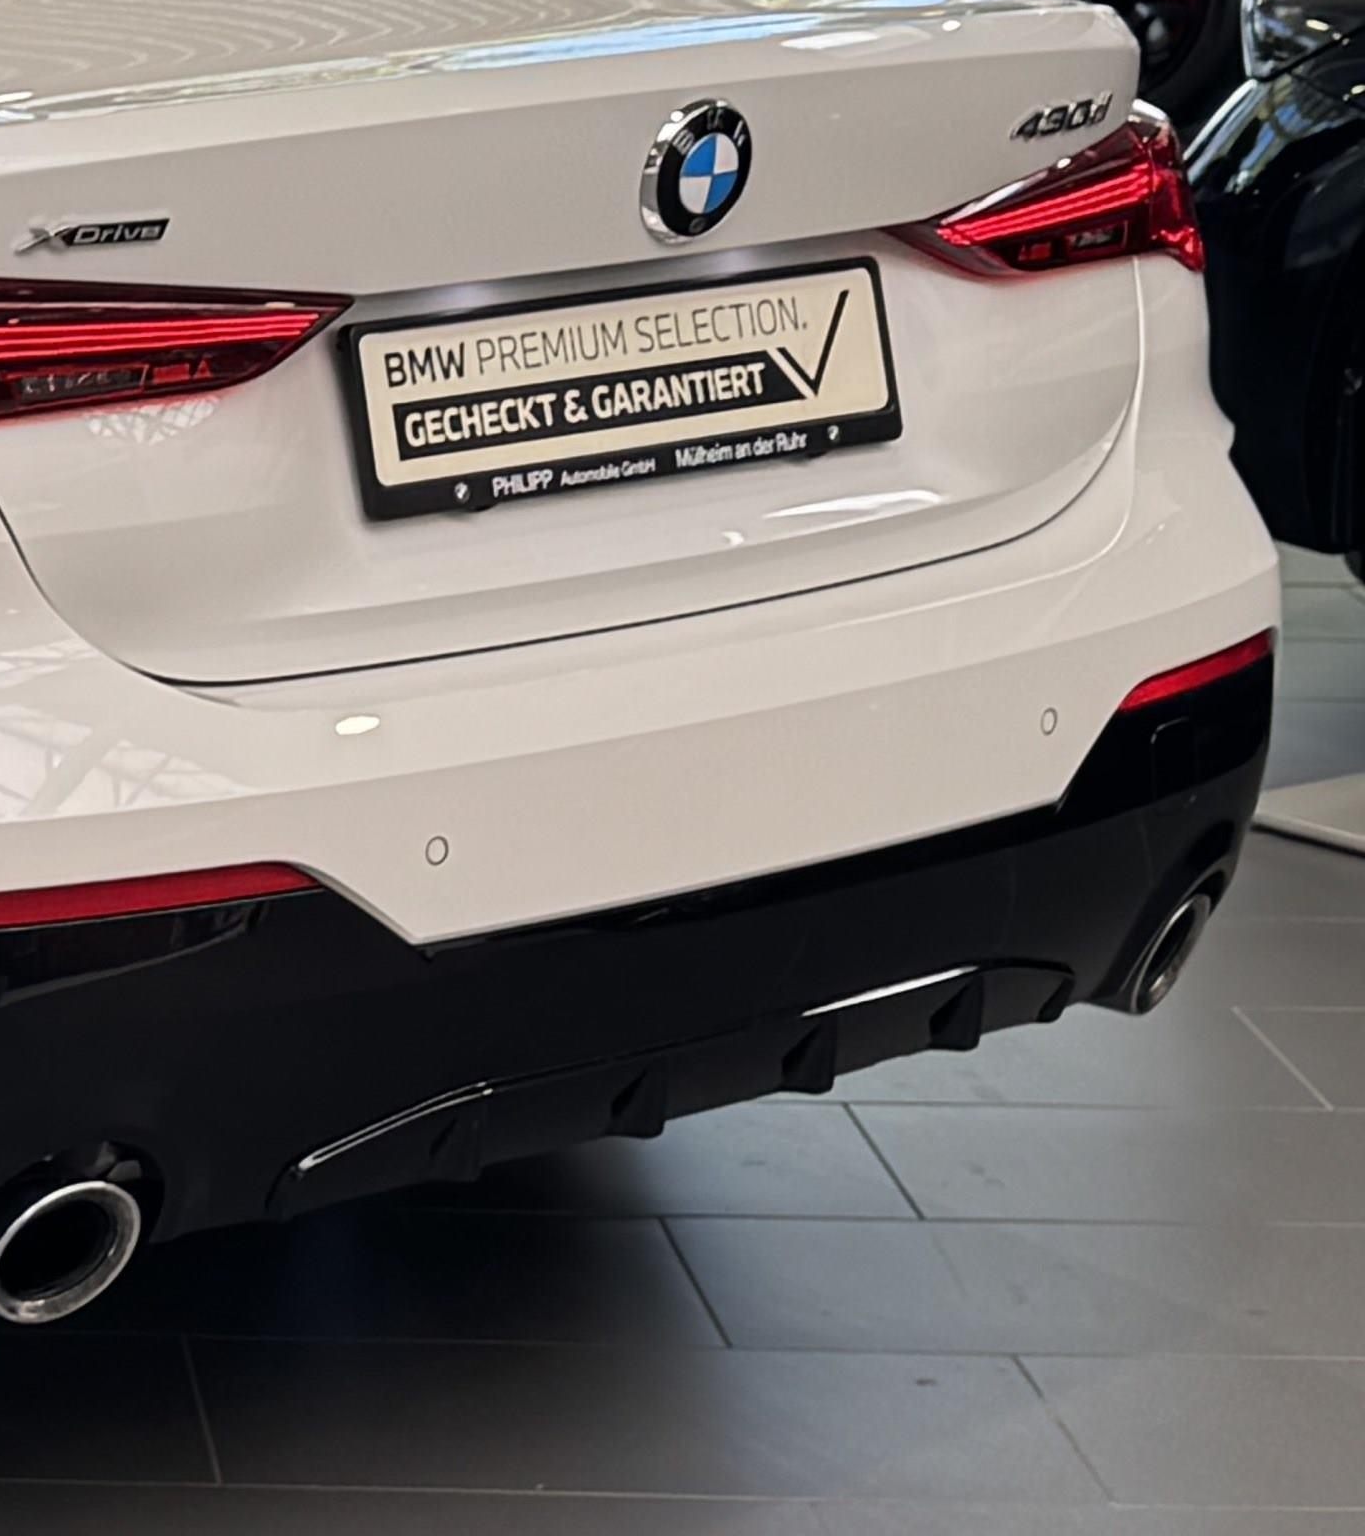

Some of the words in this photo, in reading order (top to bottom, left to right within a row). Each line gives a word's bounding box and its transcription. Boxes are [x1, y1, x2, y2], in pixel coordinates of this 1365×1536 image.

[1009, 91, 1113, 141] 430d
[384, 342, 465, 387] BMW
[476, 320, 628, 374] PREMIUM
[404, 393, 557, 447] GECHECKT
[563, 389, 589, 424] &
[591, 362, 766, 421] GARANTIERT
[491, 468, 553, 498] PHILIPP
[560, 462, 620, 487] Automobile
[621, 458, 656, 478] GmbH
[675, 442, 733, 468] Mülheim
[735, 441, 752, 460] an
[754, 436, 776, 456] der
[777, 431, 809, 451] Ruhr
